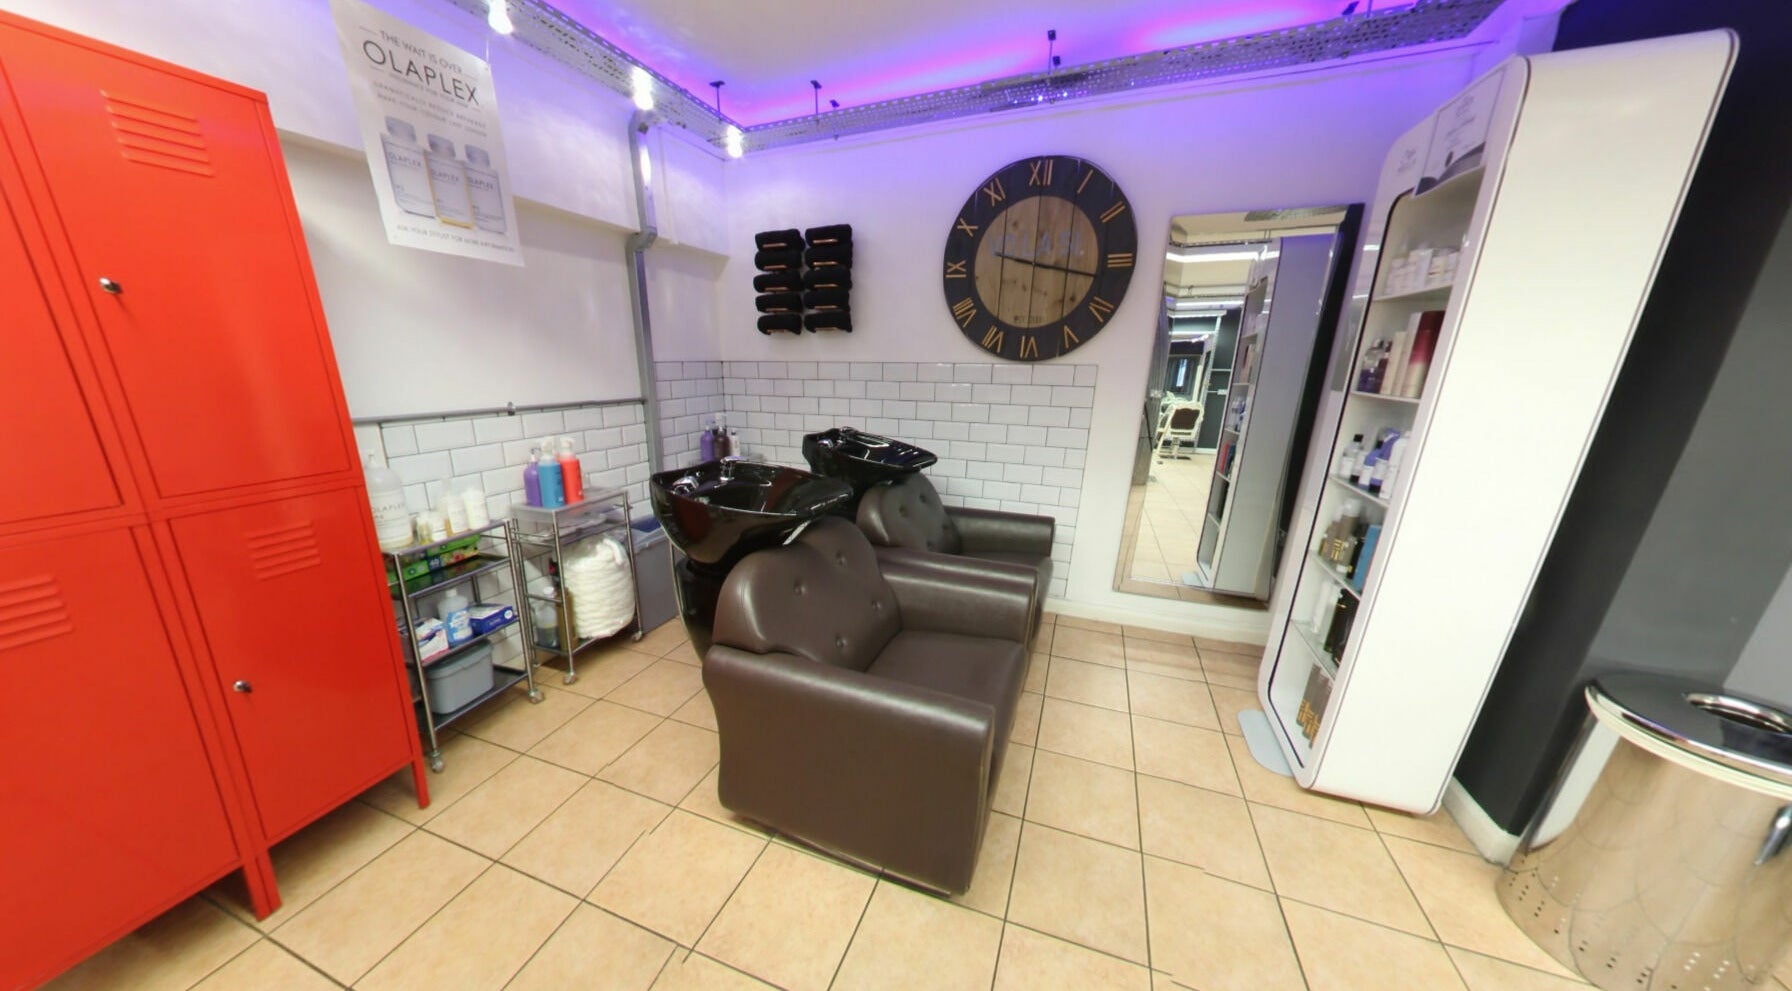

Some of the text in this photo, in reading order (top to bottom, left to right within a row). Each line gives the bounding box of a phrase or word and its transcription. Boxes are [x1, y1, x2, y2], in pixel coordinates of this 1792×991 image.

[380, 30, 462, 74] THE WAIT IS OVER
[363, 40, 479, 105] OLAPLEX
[1029, 159, 1054, 186] XII
[983, 177, 1006, 207] XI
[957, 218, 978, 237] X
[945, 260, 967, 278] IX
[1107, 253, 1133, 268] III
[1020, 336, 1038, 359] VI
[1063, 325, 1080, 349] V
